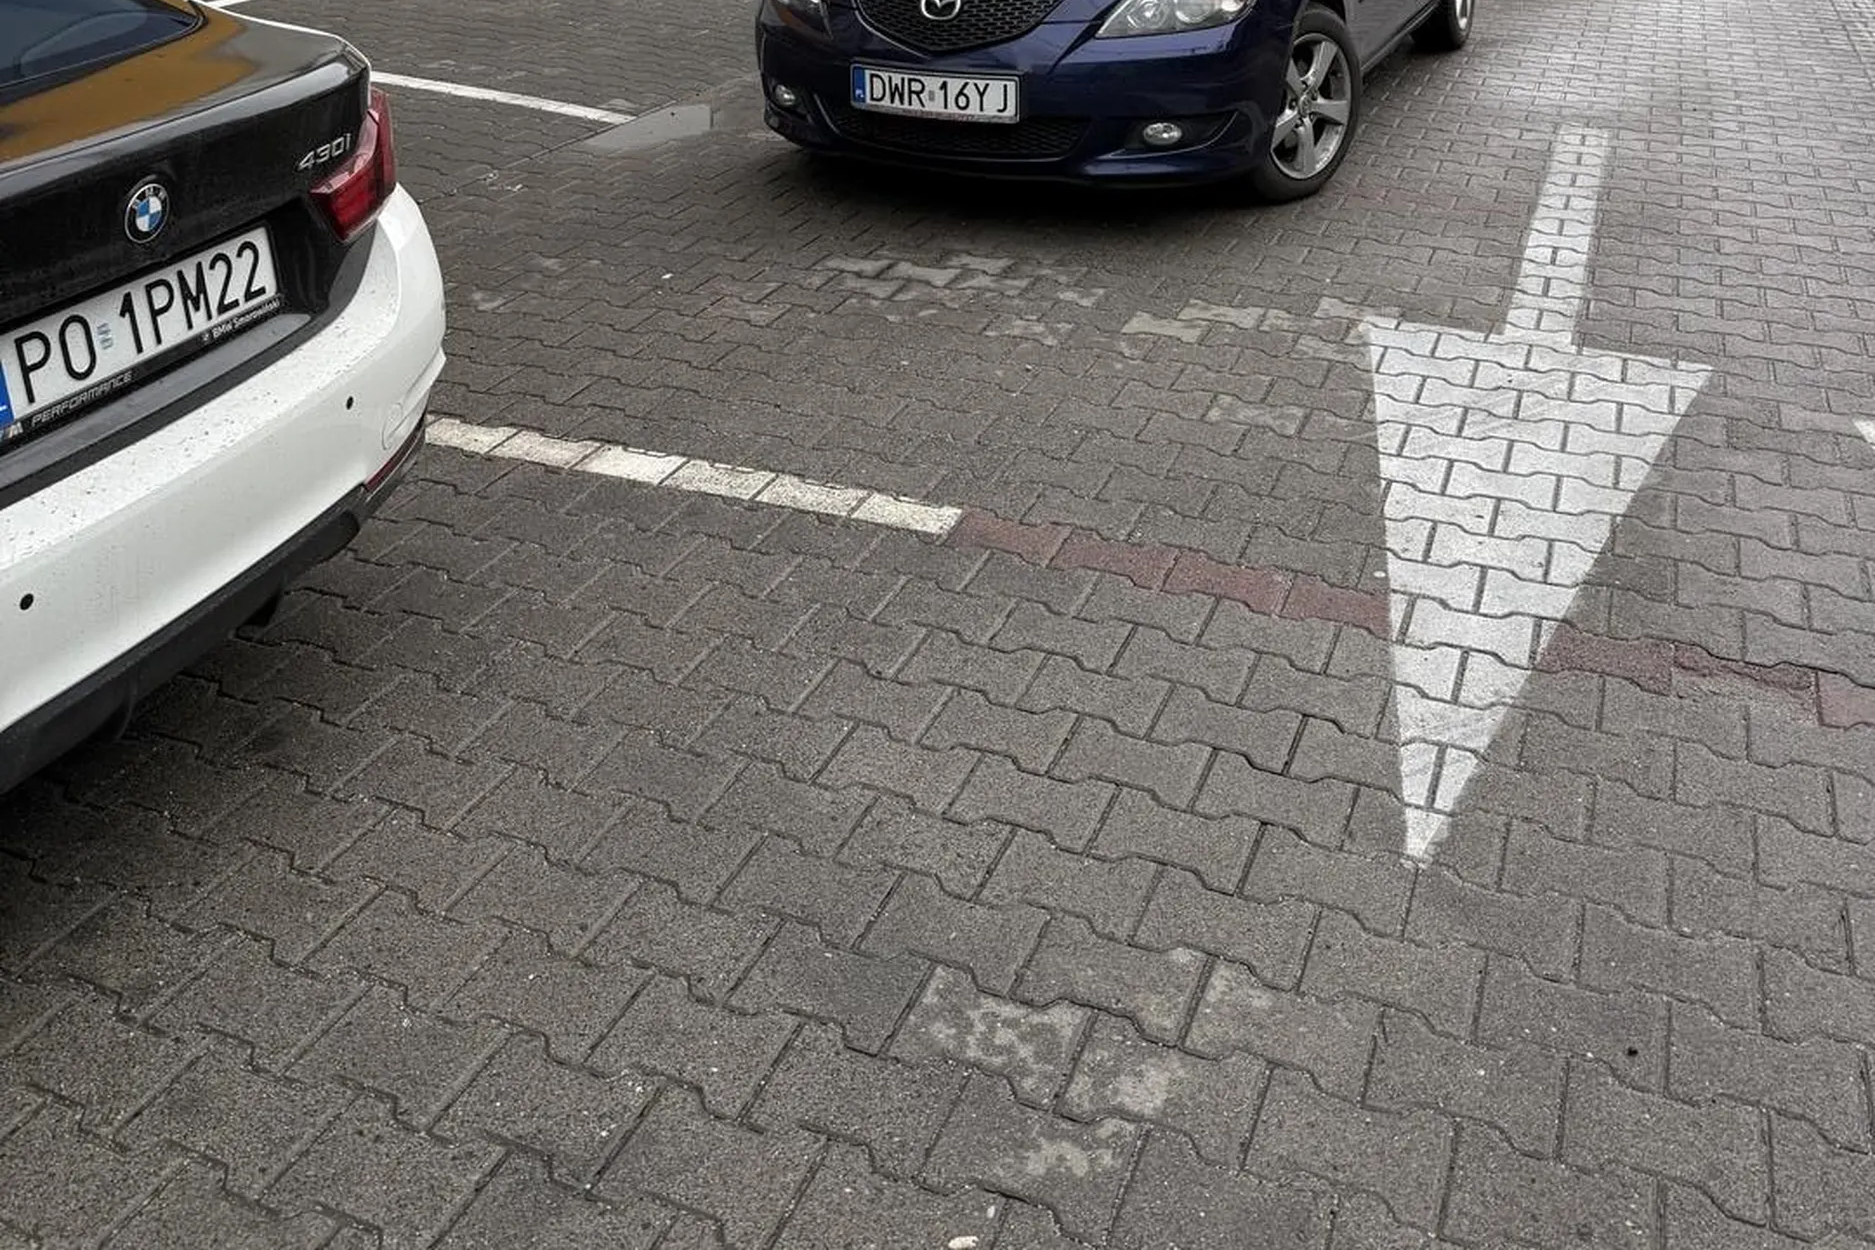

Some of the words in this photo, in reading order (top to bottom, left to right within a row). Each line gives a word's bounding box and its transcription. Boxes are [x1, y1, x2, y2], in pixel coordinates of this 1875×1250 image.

[869, 73, 926, 108] DWR
[939, 80, 1008, 113] 16YJ
[299, 133, 351, 170] 430i
[13, 313, 97, 404] PO
[119, 240, 267, 354] 1PM22
[31, 370, 133, 428] PERFORMANCE
